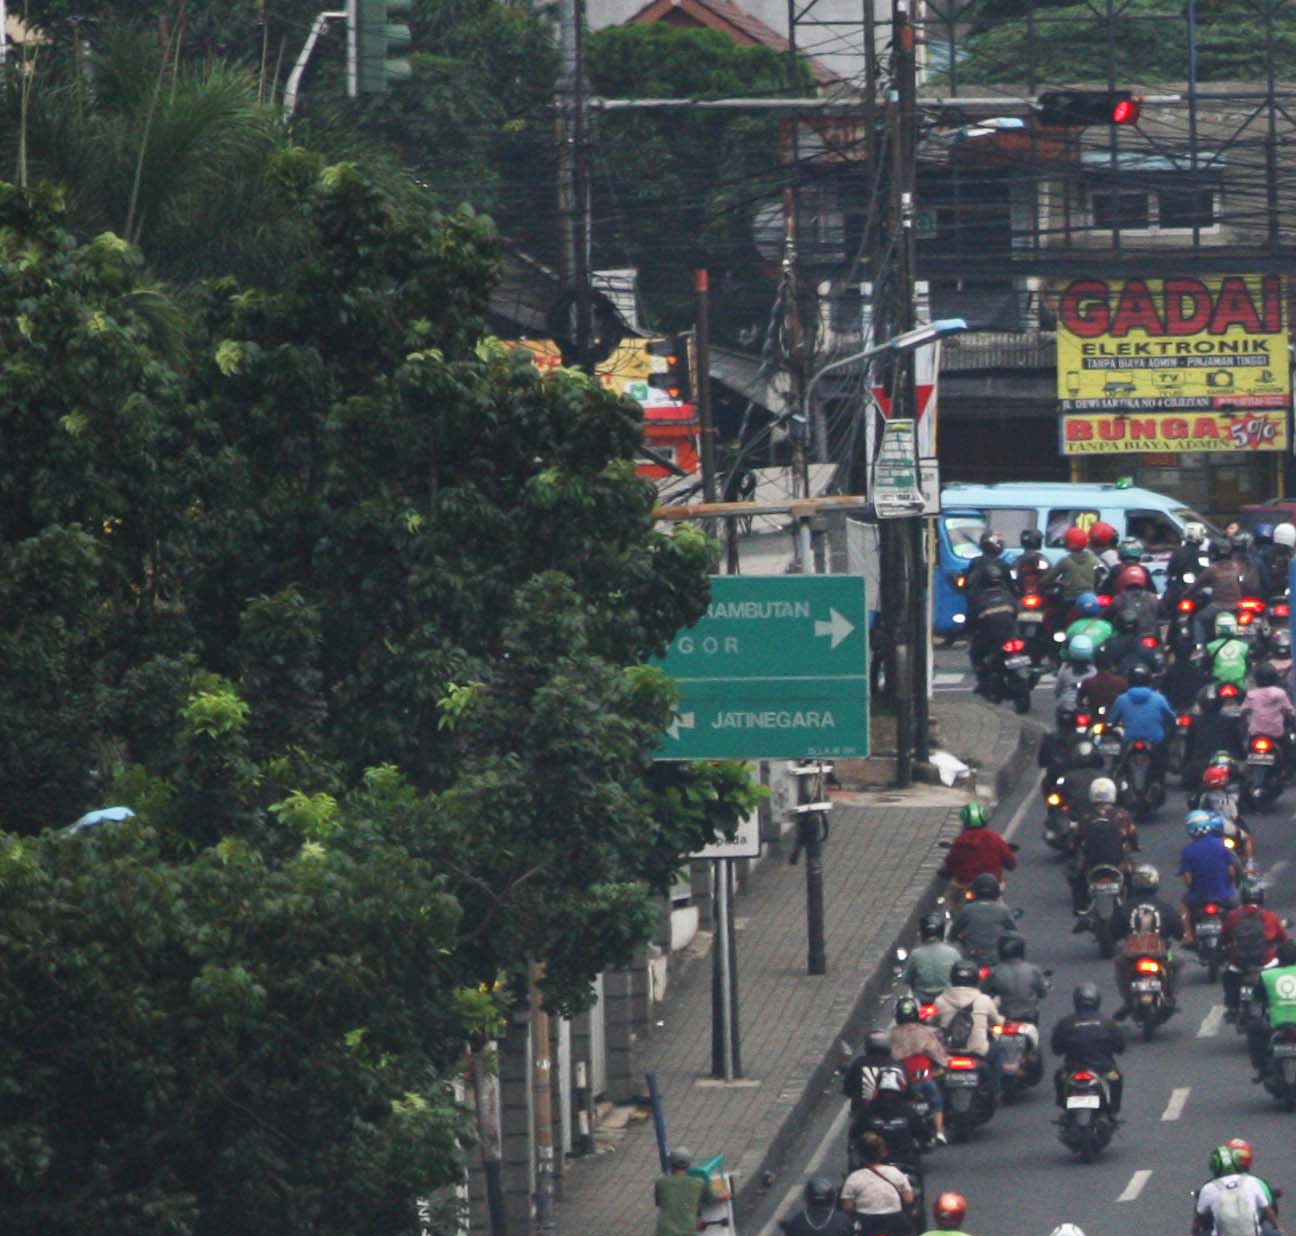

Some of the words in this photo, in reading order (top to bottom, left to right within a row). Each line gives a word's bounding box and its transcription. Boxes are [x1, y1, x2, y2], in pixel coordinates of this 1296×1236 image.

[1058, 276, 1282, 338] GADAI
[1082, 339, 1270, 356] ELEKTRONIK
[1087, 358, 1116, 369] TANPA
[1118, 358, 1146, 368] BIAYA
[1149, 357, 1178, 367] ADMIN
[1187, 356, 1234, 367] PINJAMAN
[1236, 355, 1267, 365] TINGGI
[1159, 373, 1179, 382] TV
[1064, 417, 1221, 441] BUNGA
[1231, 416, 1276, 448] 5%
[1067, 441, 1120, 451] TANPA
[1125, 440, 1170, 450] BIAYA
[1174, 438, 1230, 449] ADMIN
[712, 711, 836, 729] JATINEGARA
